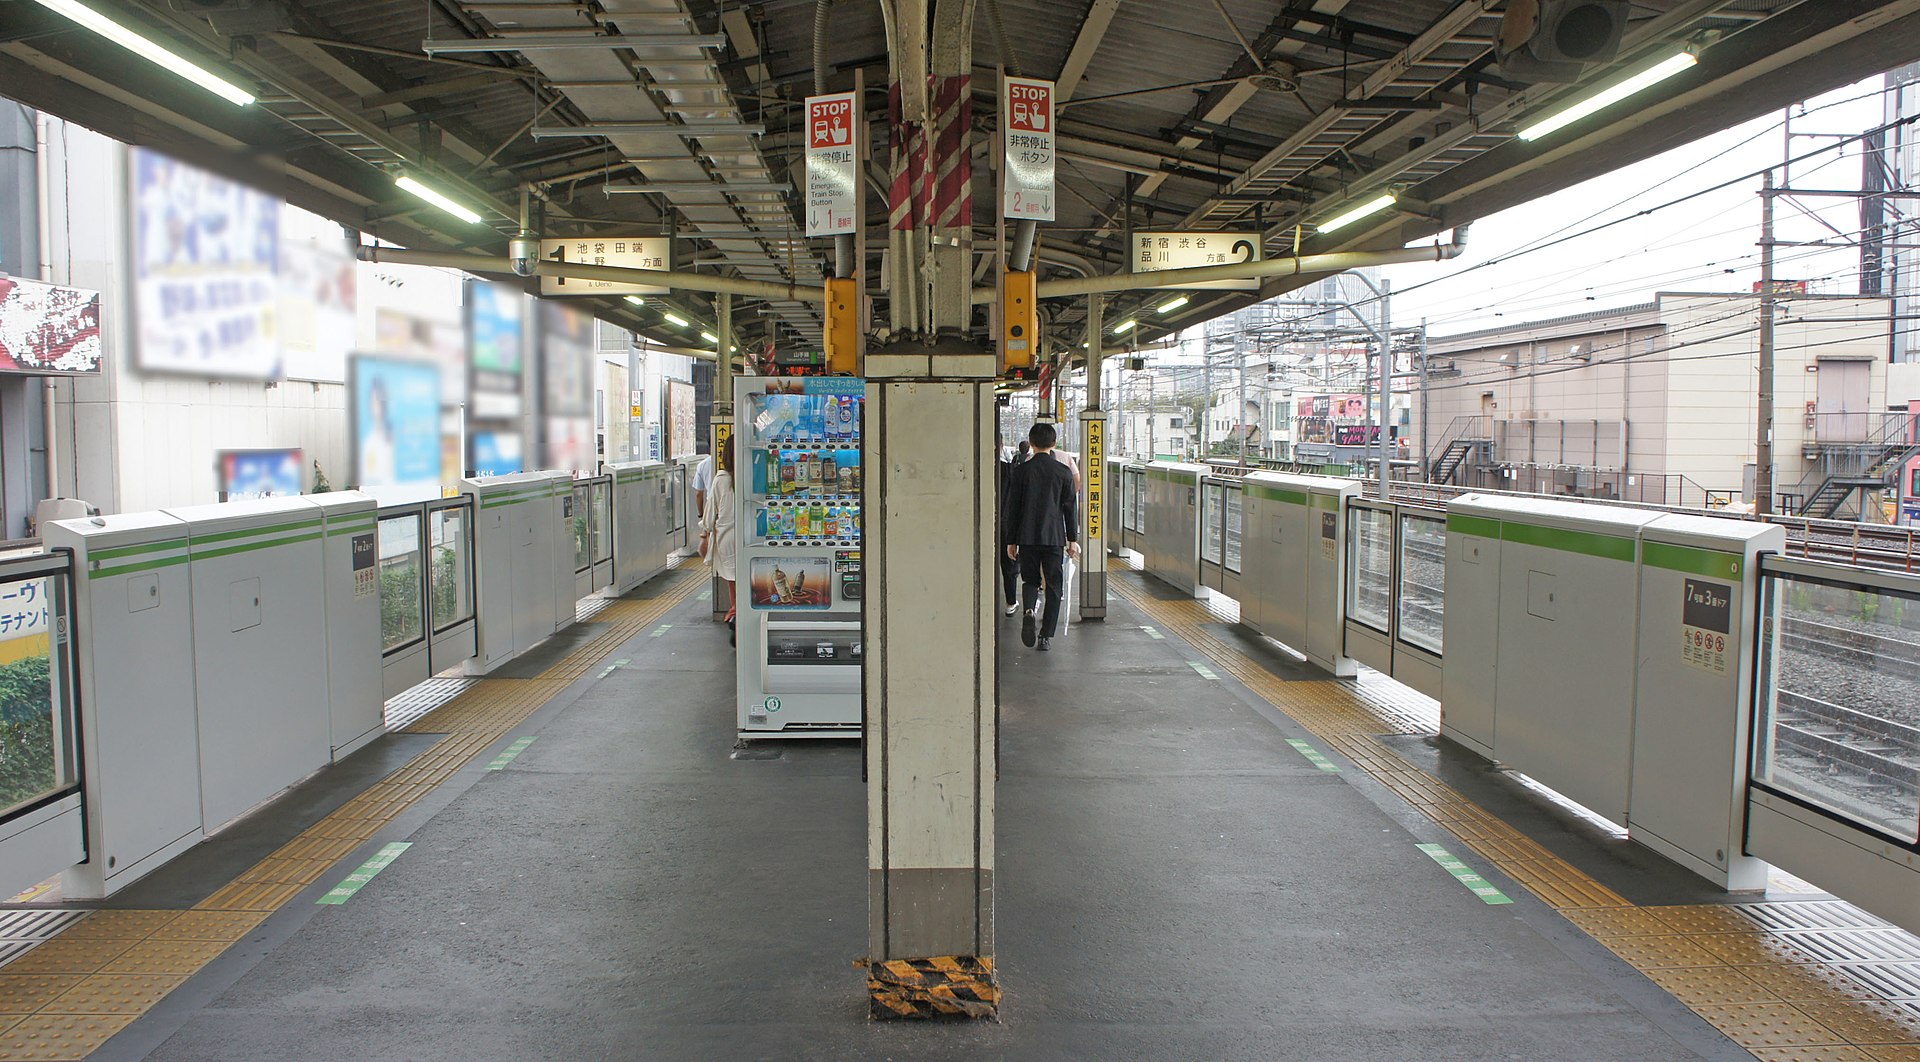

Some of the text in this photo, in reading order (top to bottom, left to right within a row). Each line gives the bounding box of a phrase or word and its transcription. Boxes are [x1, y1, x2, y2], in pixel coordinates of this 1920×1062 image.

[1010, 86, 1048, 101] STOP
[813, 102, 849, 117] STOP
[1010, 134, 1050, 150] 非常停止
[811, 150, 852, 166] 非常停止
[1020, 151, 1050, 164] ボタン
[828, 189, 844, 197] Stop
[811, 199, 833, 207] Button
[1013, 191, 1022, 212] 2
[827, 208, 832, 229] 1
[577, 242, 643, 254] 池袋 田端
[1141, 237, 1207, 249] 新宿 渋谷
[642, 257, 662, 267] 方面
[1141, 251, 1226, 263] 品川 方面
[1090, 434, 1100, 535] 改札口は一箇所です
